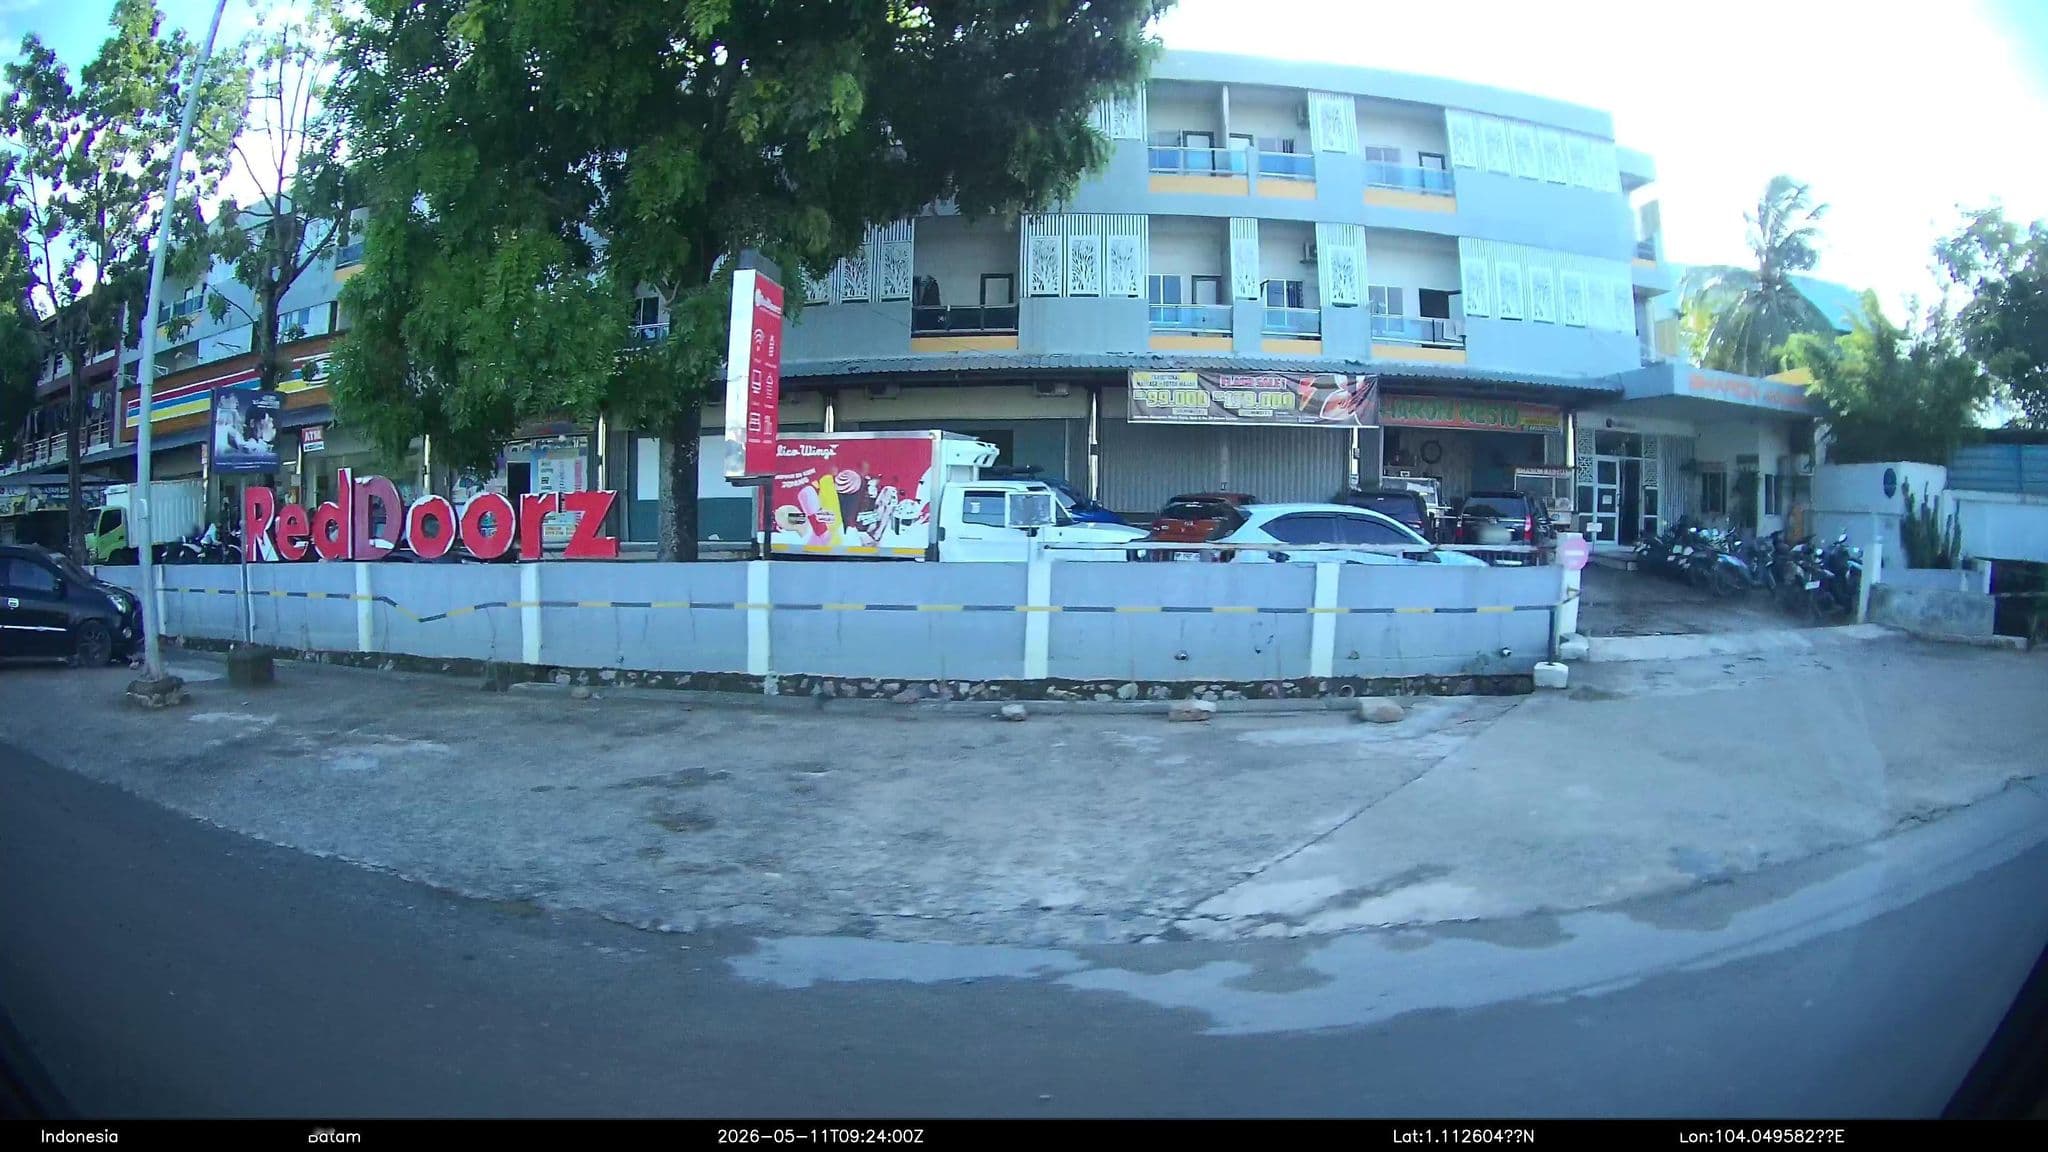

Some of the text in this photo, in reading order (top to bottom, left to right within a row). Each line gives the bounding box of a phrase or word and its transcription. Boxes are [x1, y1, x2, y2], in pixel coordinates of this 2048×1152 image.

[304, 430, 322, 442] ATM
[776, 444, 839, 460] lico Wings
[245, 467, 619, 562] RedDoorz
